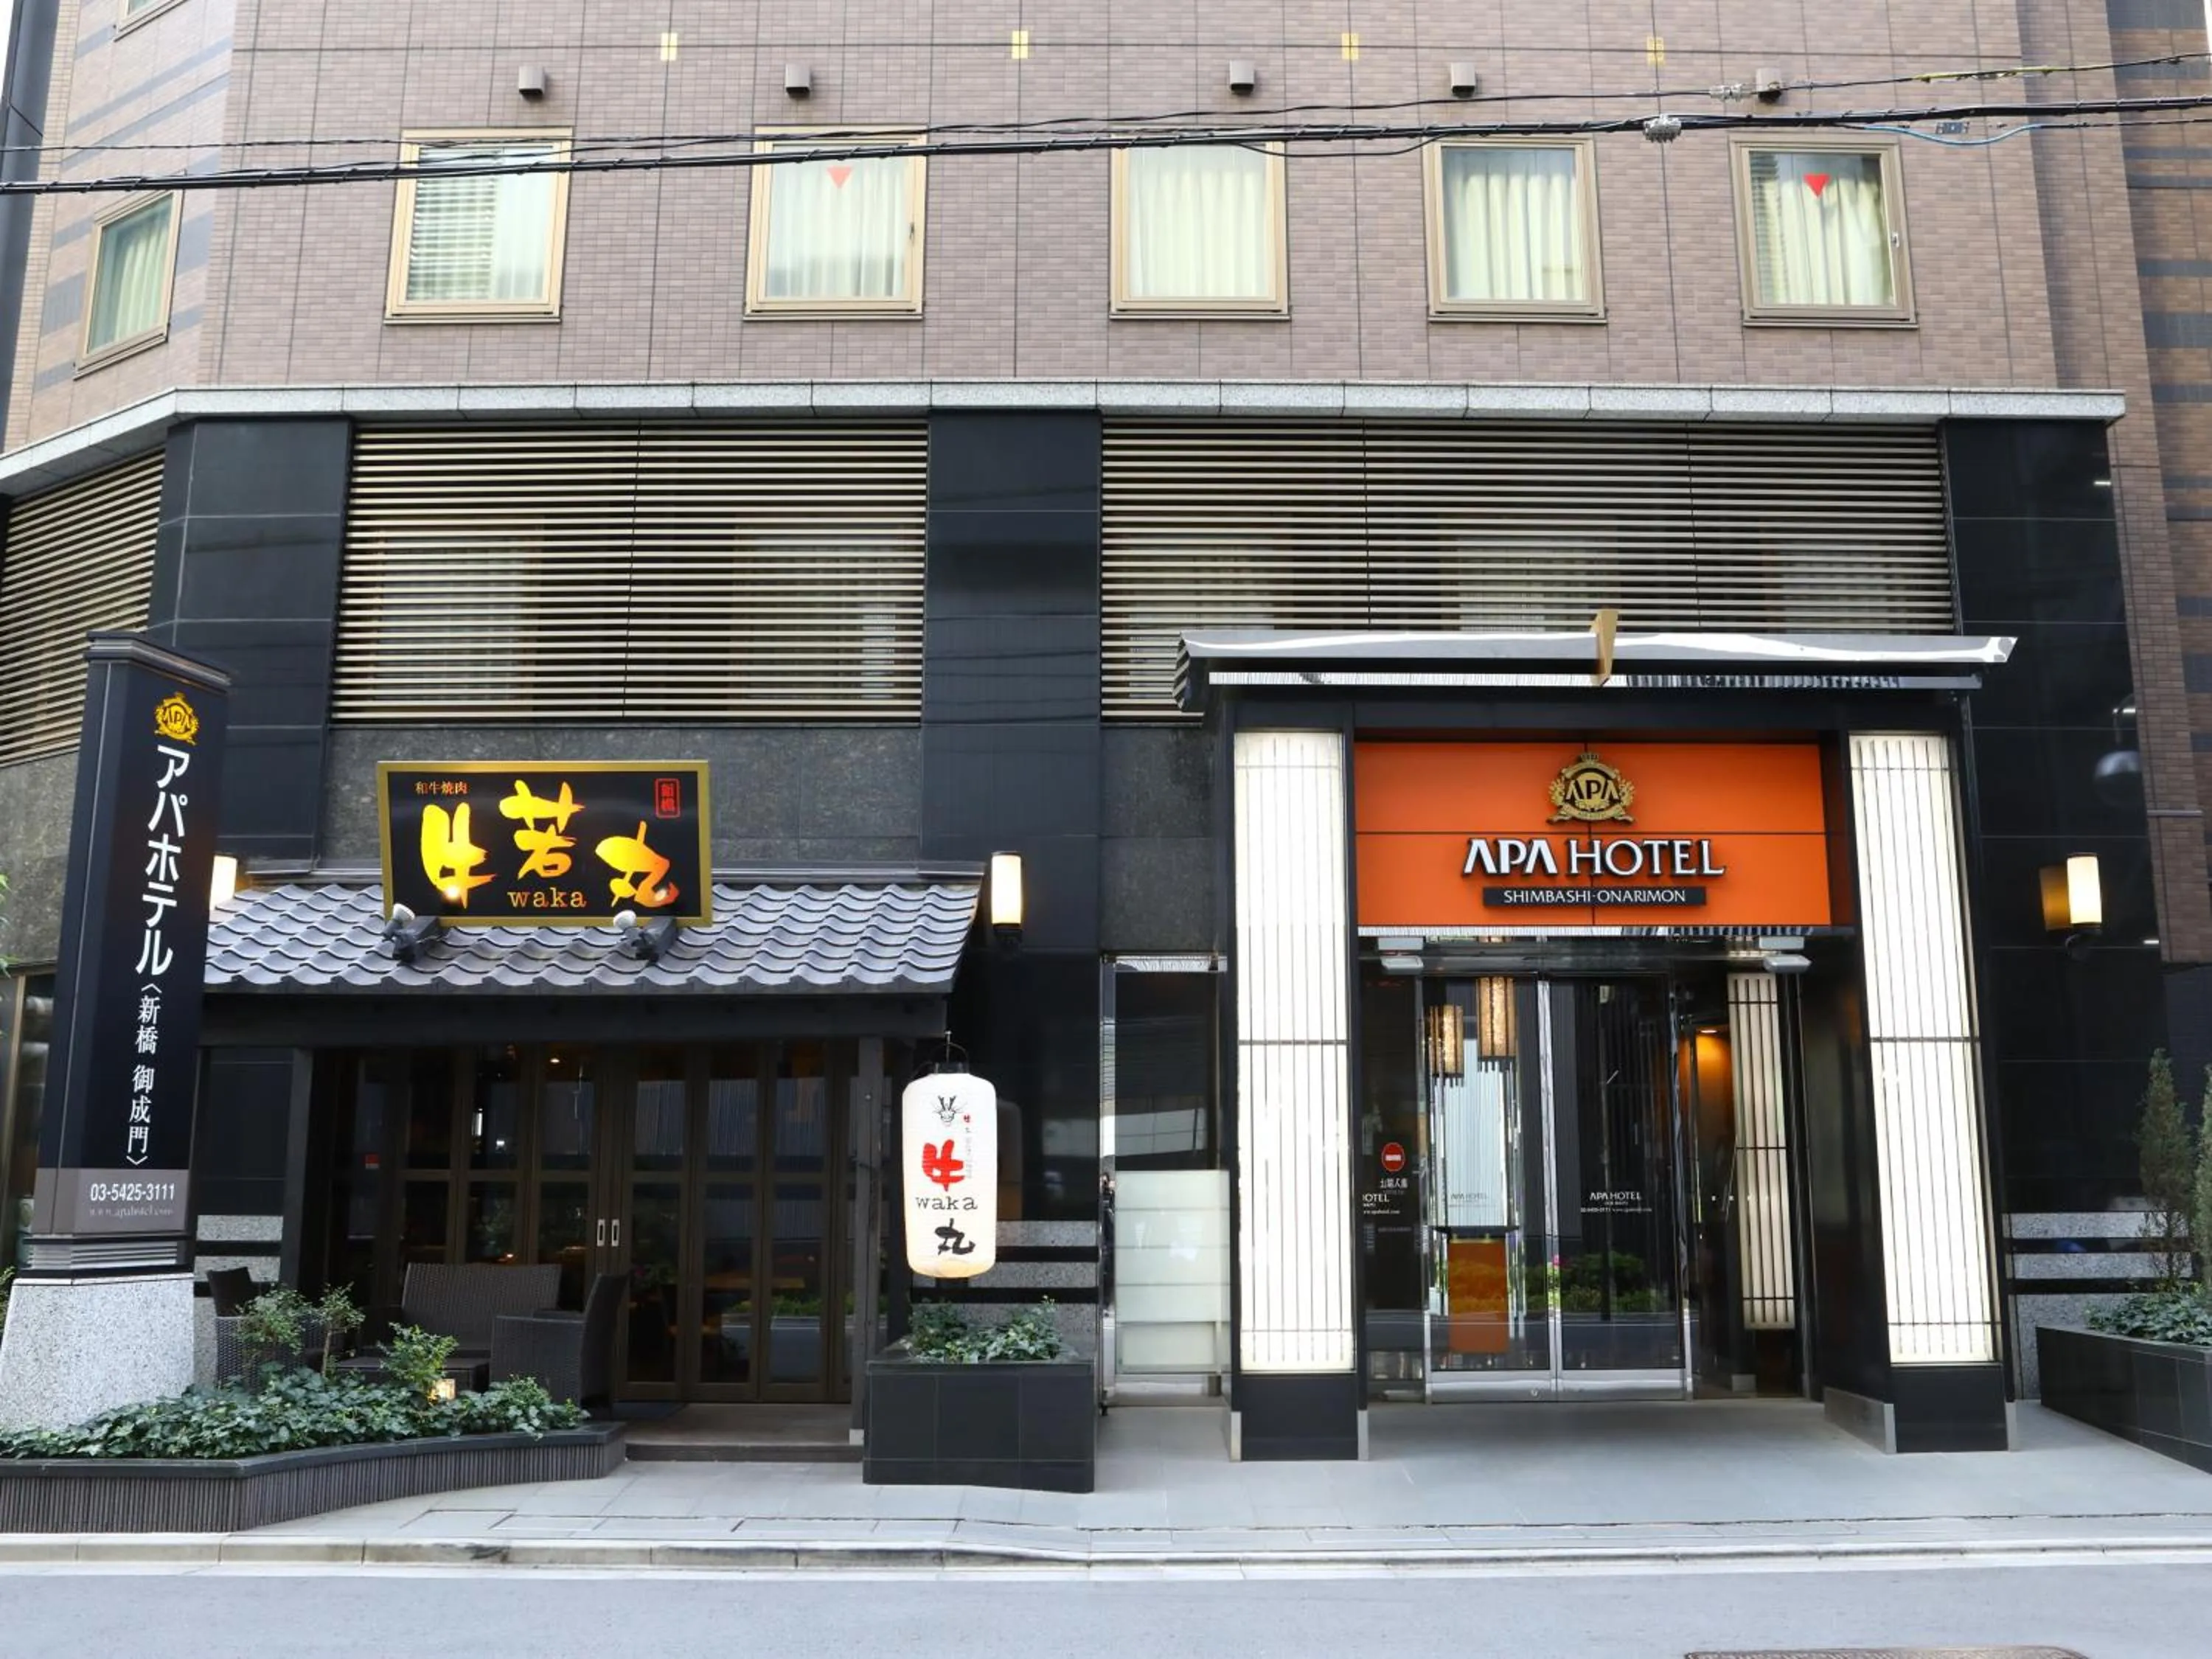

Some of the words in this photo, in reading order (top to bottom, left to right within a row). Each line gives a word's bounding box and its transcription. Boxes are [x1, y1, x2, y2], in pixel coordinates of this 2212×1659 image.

[1565, 779, 1620, 801] APA
[135, 745, 191, 976] アパホテル
[1464, 838, 1557, 874] APA
[1569, 839, 1725, 876] HOTEL
[507, 886, 587, 908] waka
[90, 1183, 175, 1201] 03-5425-3111
[916, 1195, 978, 1210] waka
[1590, 1192, 1608, 1200] APA
[1610, 1192, 1641, 1200] HOTEL
[934, 1218, 975, 1256] 丸
